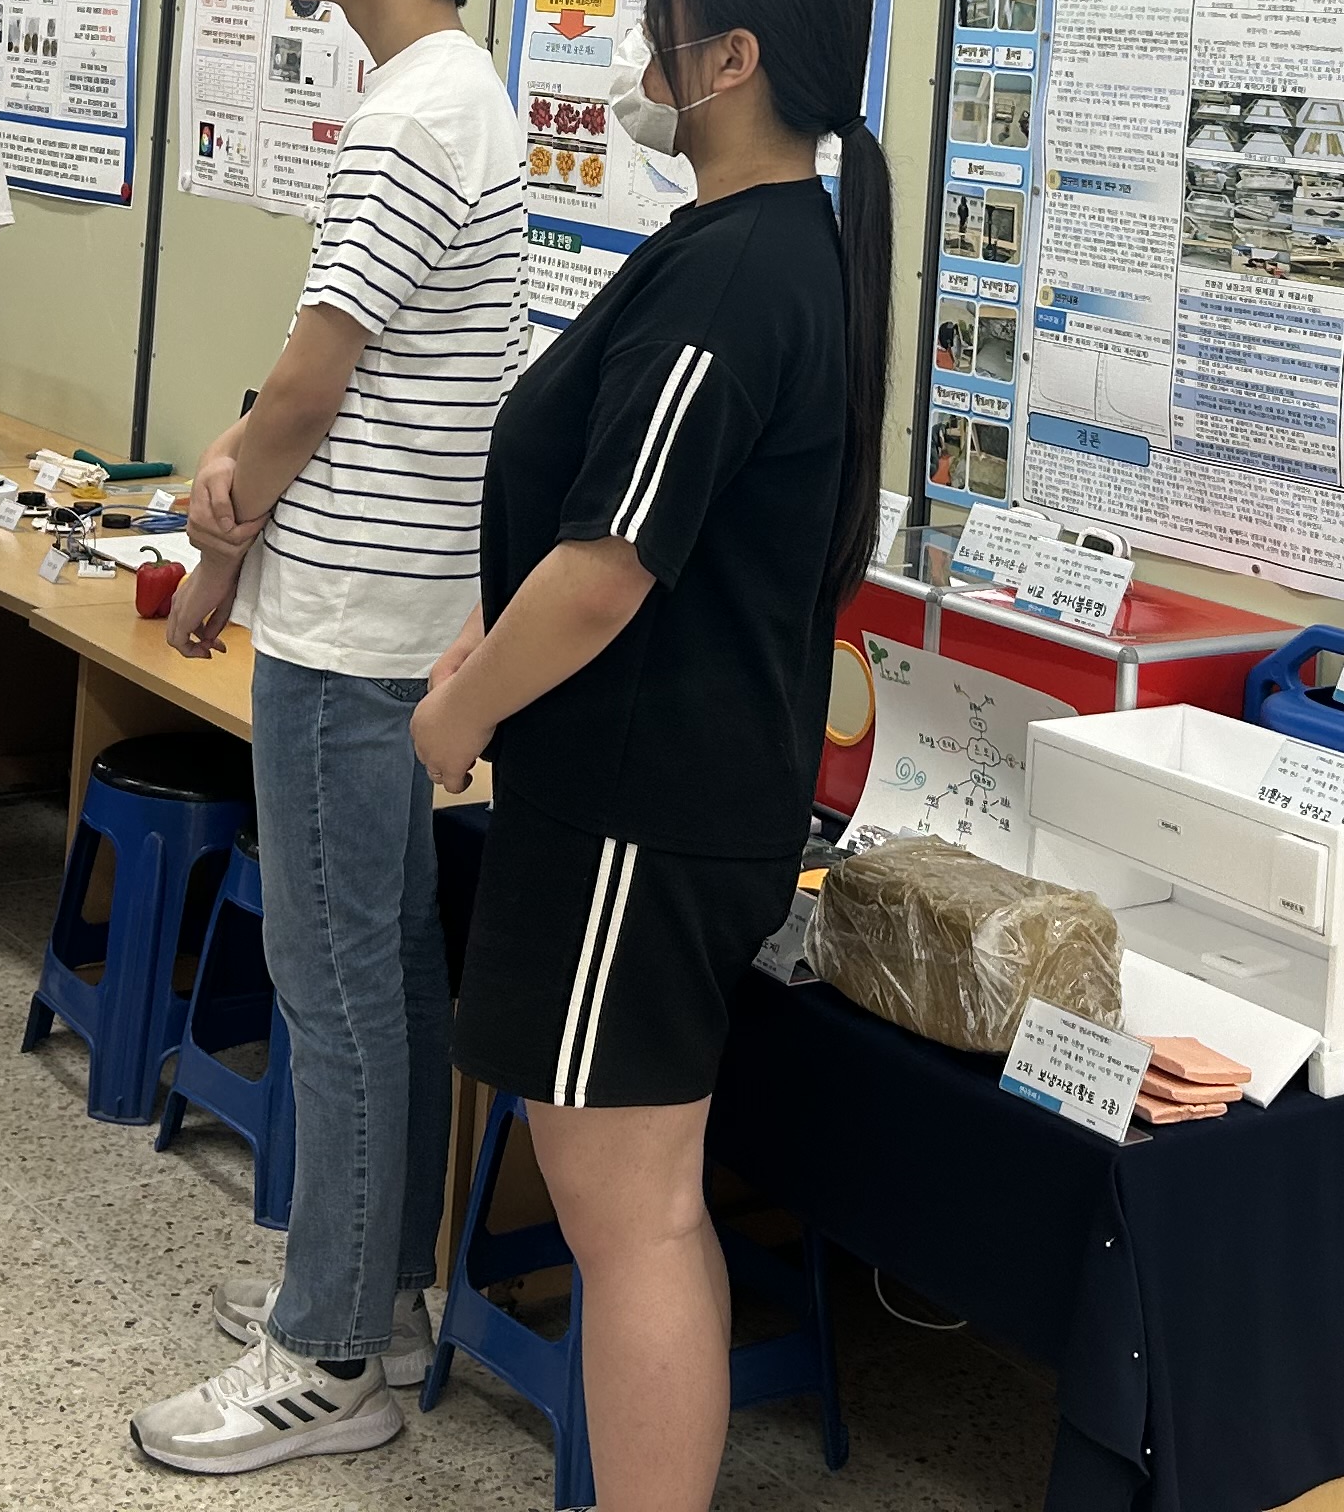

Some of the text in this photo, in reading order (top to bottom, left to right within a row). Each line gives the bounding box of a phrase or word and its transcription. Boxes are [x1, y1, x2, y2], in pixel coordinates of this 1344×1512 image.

[1077, 429, 1102, 449] 결론
[1258, 786, 1332, 824] 친환경 냉장고
